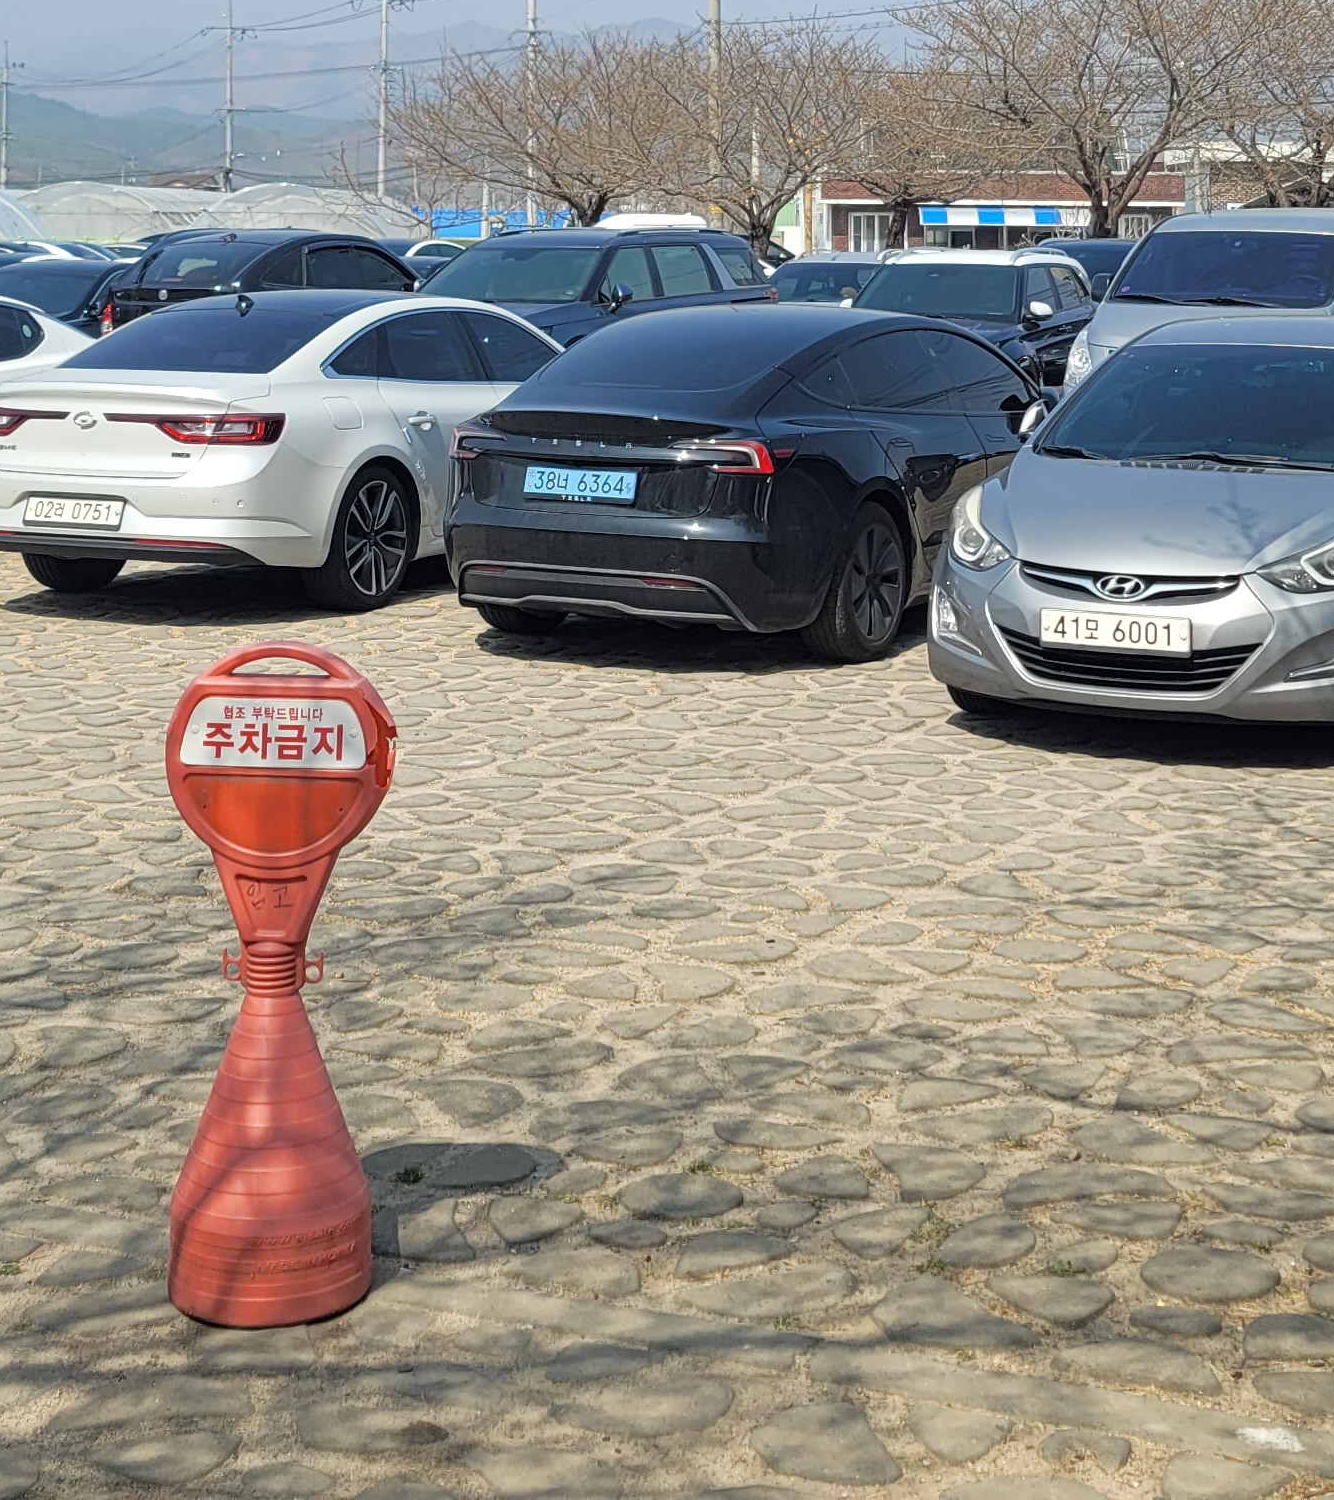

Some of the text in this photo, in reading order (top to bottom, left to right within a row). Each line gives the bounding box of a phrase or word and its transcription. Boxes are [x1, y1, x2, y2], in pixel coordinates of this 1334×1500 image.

[531, 437, 632, 449] TESLA
[534, 470, 625, 495] 38너 6364
[71, 502, 112, 521] 0751
[1053, 615, 1172, 646] 41모 6001
[223, 705, 324, 722] 협조 부탁드립니다
[202, 722, 345, 761] 주차금지
